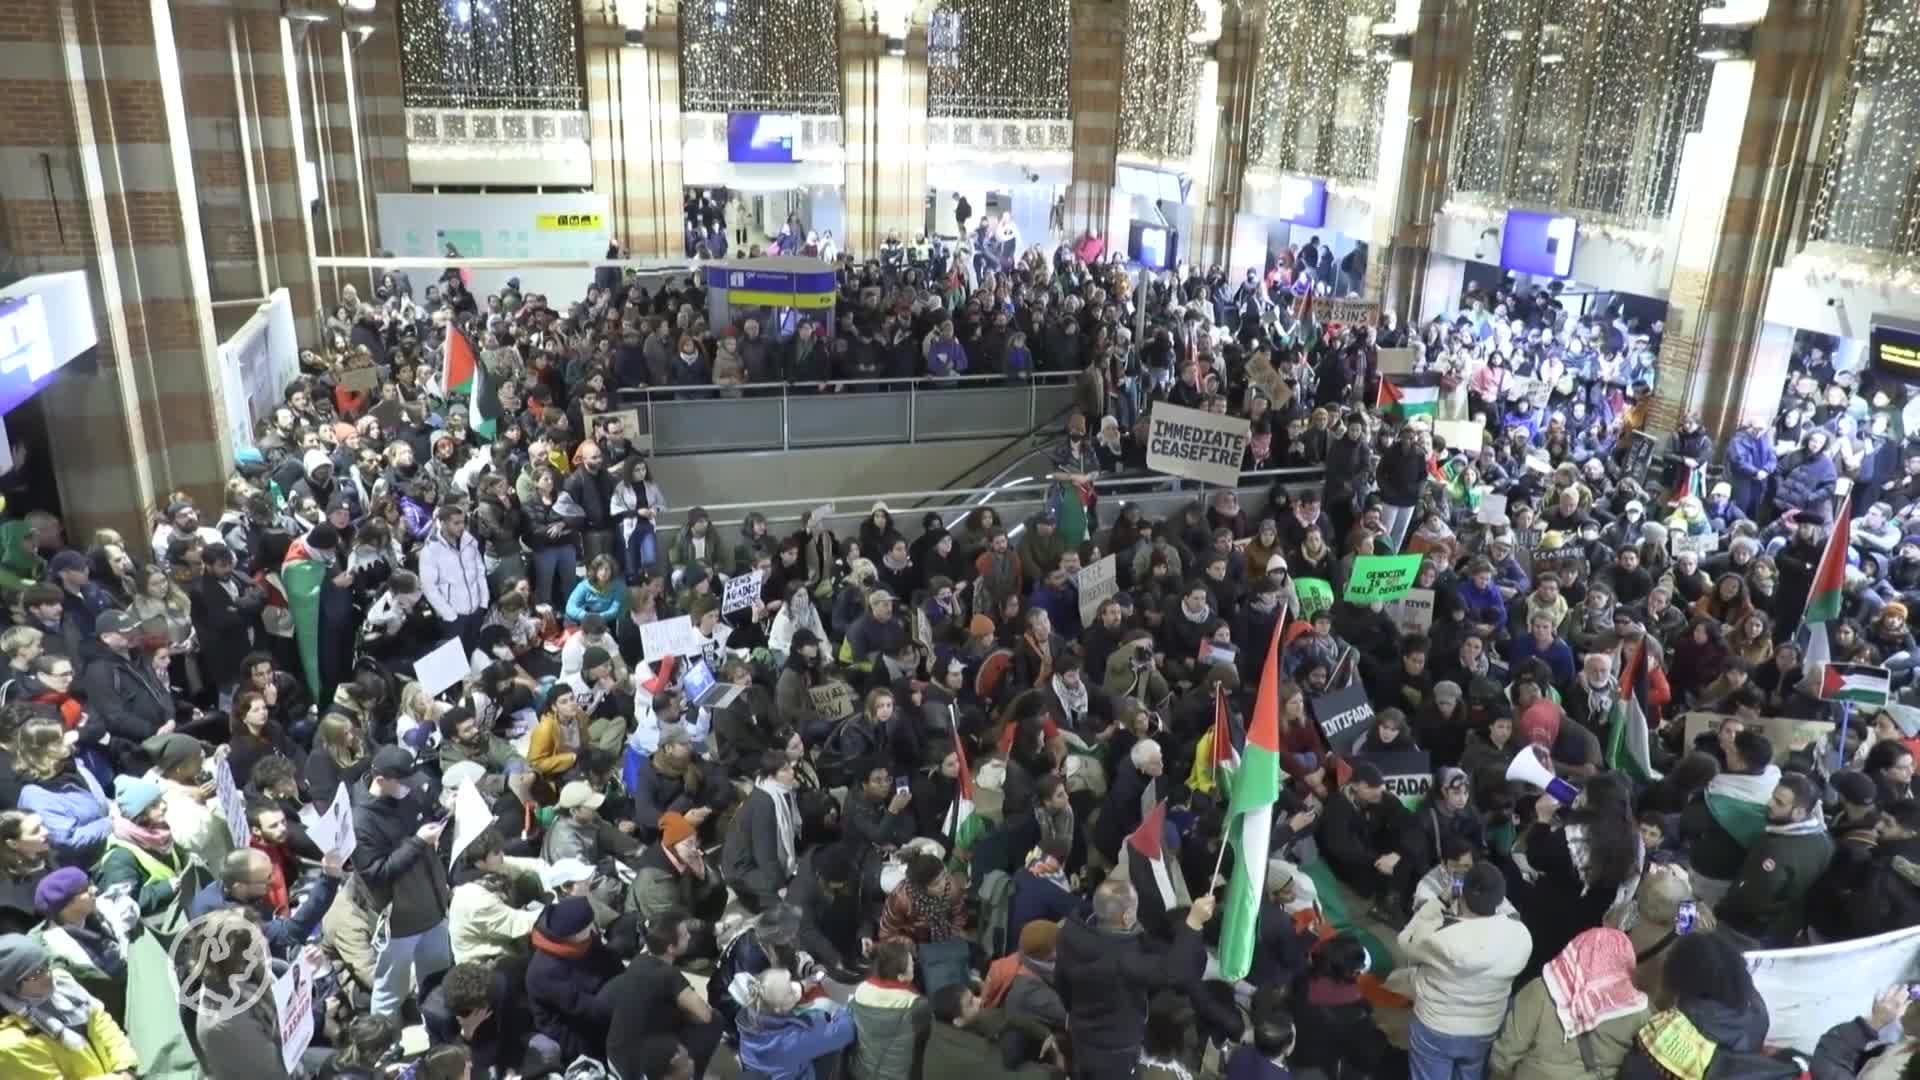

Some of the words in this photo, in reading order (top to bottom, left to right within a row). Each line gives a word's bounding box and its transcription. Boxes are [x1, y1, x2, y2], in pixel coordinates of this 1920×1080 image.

[1317, 311, 1368, 323] SASSINS
[1152, 419, 1245, 451] IMMEDIATE
[1151, 438, 1242, 468] CEASEFIRE
[1366, 568, 1407, 579] GENOCIDE
[726, 580, 761, 601] AGAINST
[727, 576, 752, 590] JEWS
[1351, 585, 1375, 595] SELF
[1321, 702, 1375, 737] INTIFADA
[1385, 778, 1431, 796] FADA
